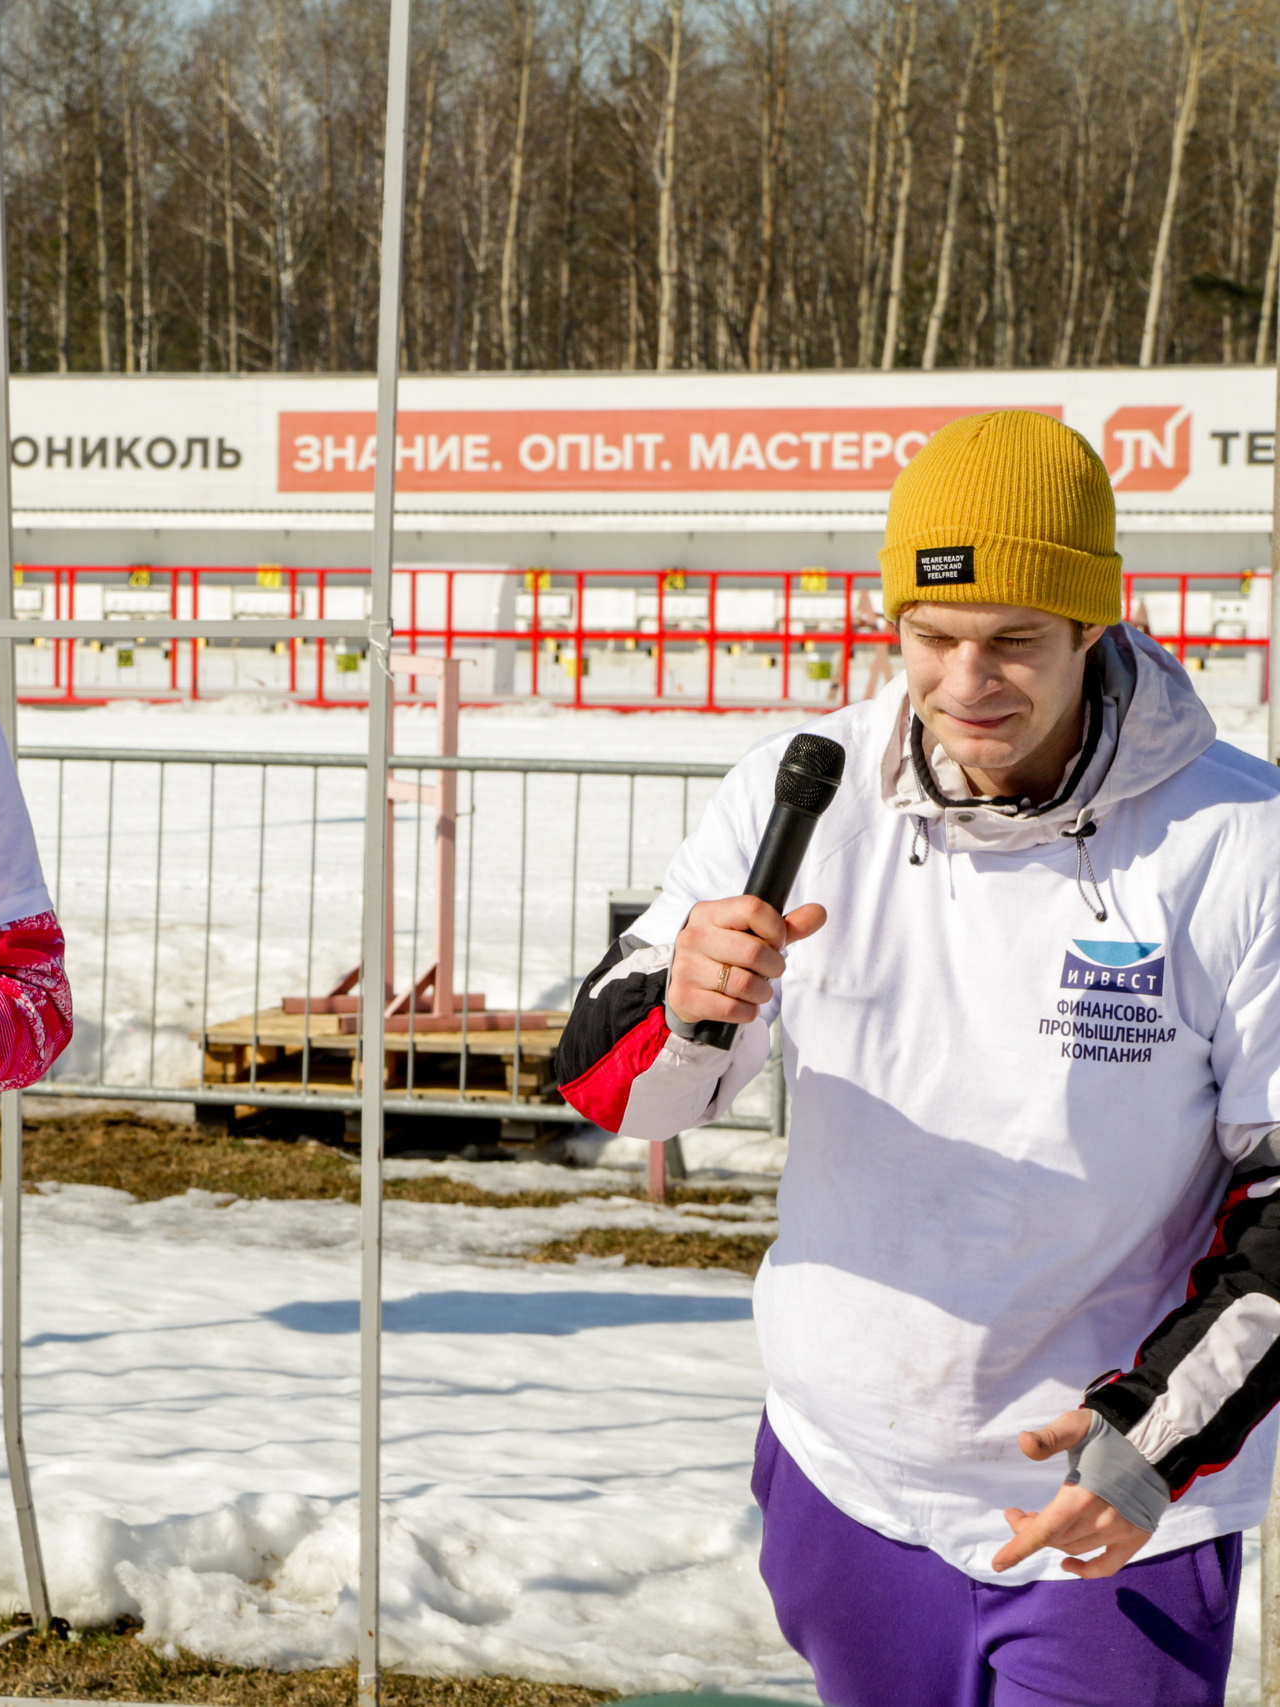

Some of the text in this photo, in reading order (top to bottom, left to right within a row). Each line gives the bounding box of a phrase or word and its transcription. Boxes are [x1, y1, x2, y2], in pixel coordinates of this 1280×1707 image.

[518, 432, 672, 472] ОПЫТ.
[688, 431, 936, 471] МАСТЕРС
[944, 555, 964, 563] READY
[1067, 969, 1157, 991] ИНВЕСТ
[1057, 999, 1163, 1024] ФИНАНСОВО-
[1039, 1018, 1177, 1044] ПРОМЫШЛЕННАЯ
[1061, 1041, 1153, 1063] КОМПАНИЯ
